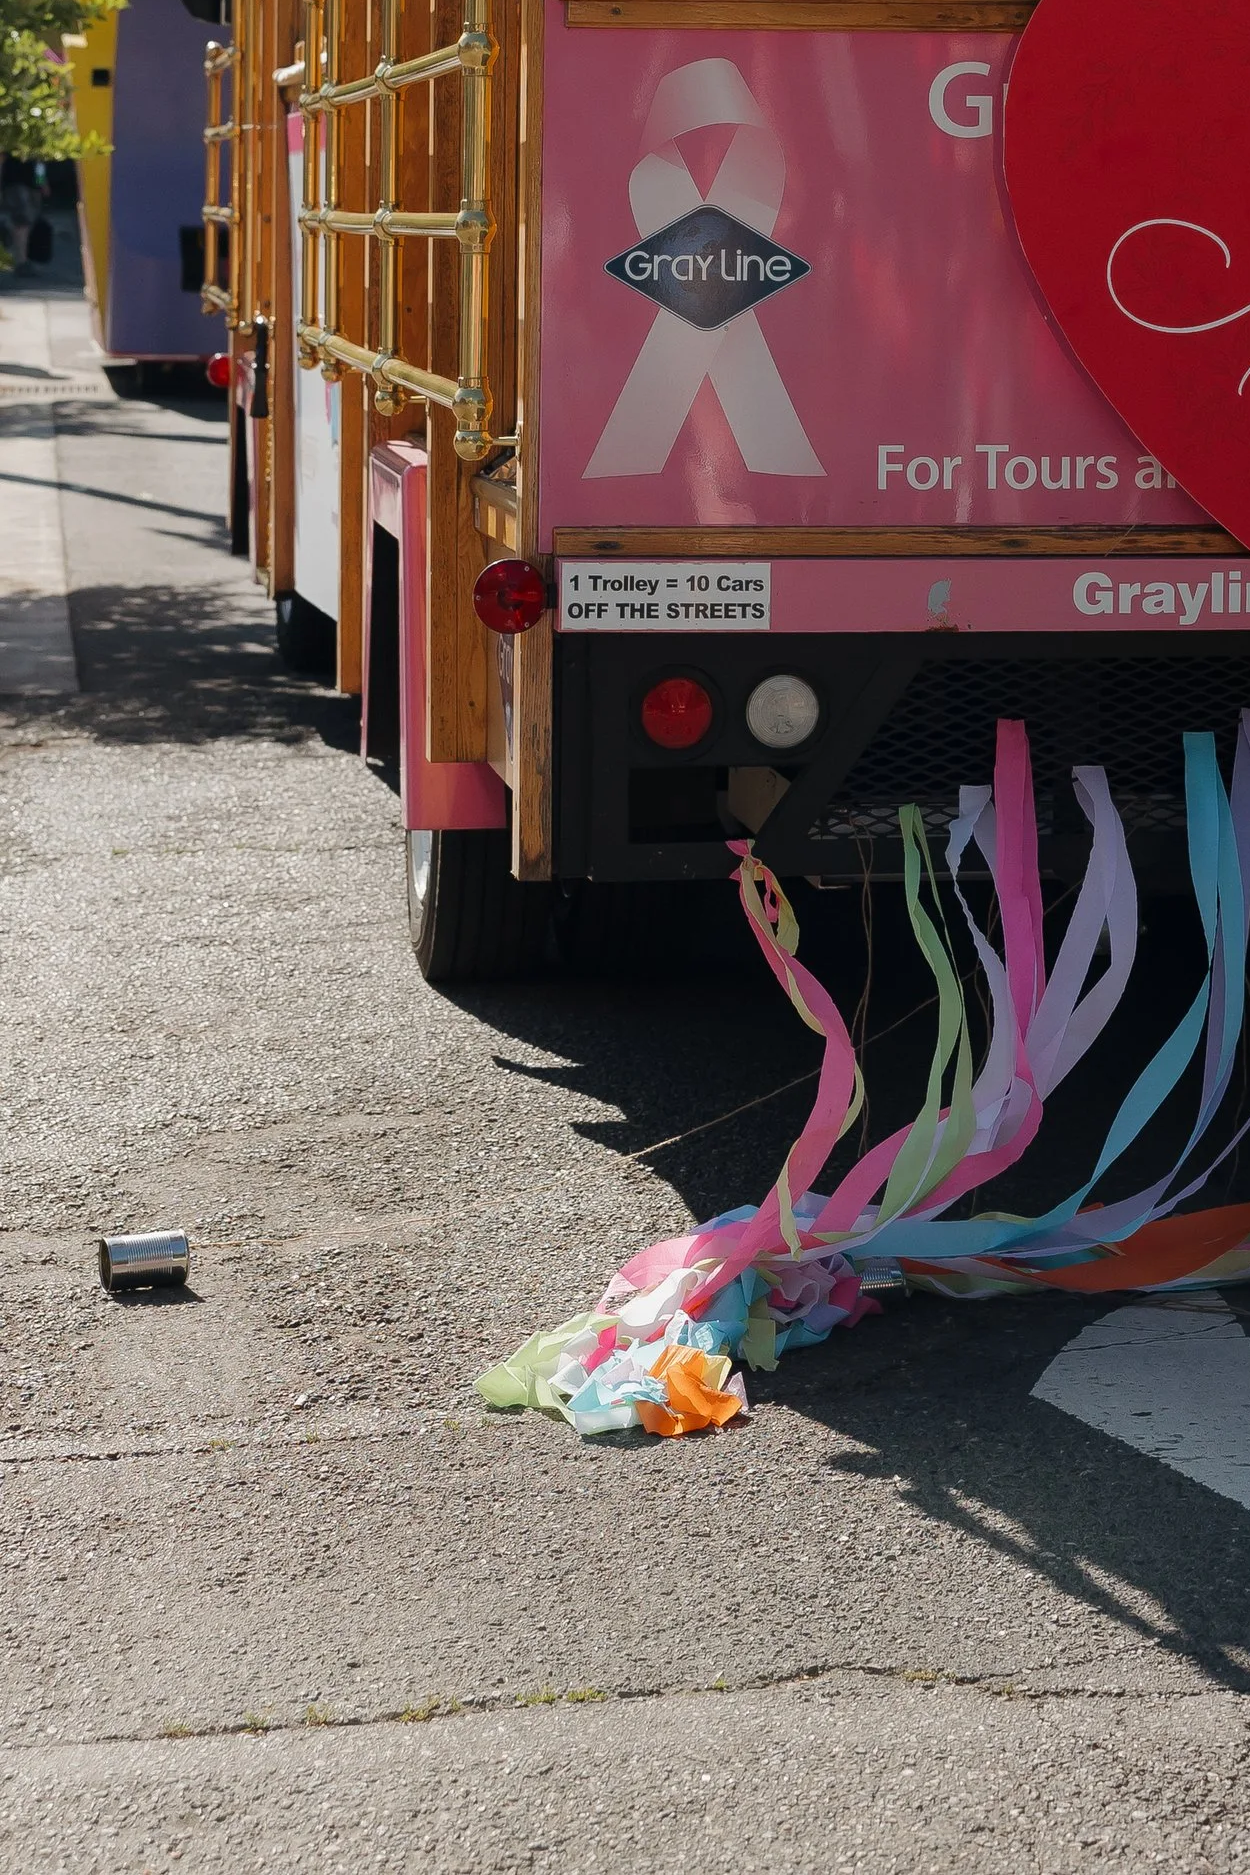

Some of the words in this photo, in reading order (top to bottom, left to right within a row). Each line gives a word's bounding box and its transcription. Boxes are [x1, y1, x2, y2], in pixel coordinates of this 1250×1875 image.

[928, 61, 1008, 139] G
[625, 250, 714, 282] Gray
[720, 249, 793, 282] Line
[877, 444, 962, 491] For
[975, 444, 1119, 491] Tours
[1134, 453, 1177, 491] a
[569, 574, 580, 592] 1
[588, 574, 660, 596] Trolley
[666, 578, 678, 589] =
[685, 574, 710, 592] 10
[716, 574, 765, 592] Cars
[567, 602, 609, 619] OFF
[615, 602, 660, 619] THE
[666, 602, 765, 620] STREETS
